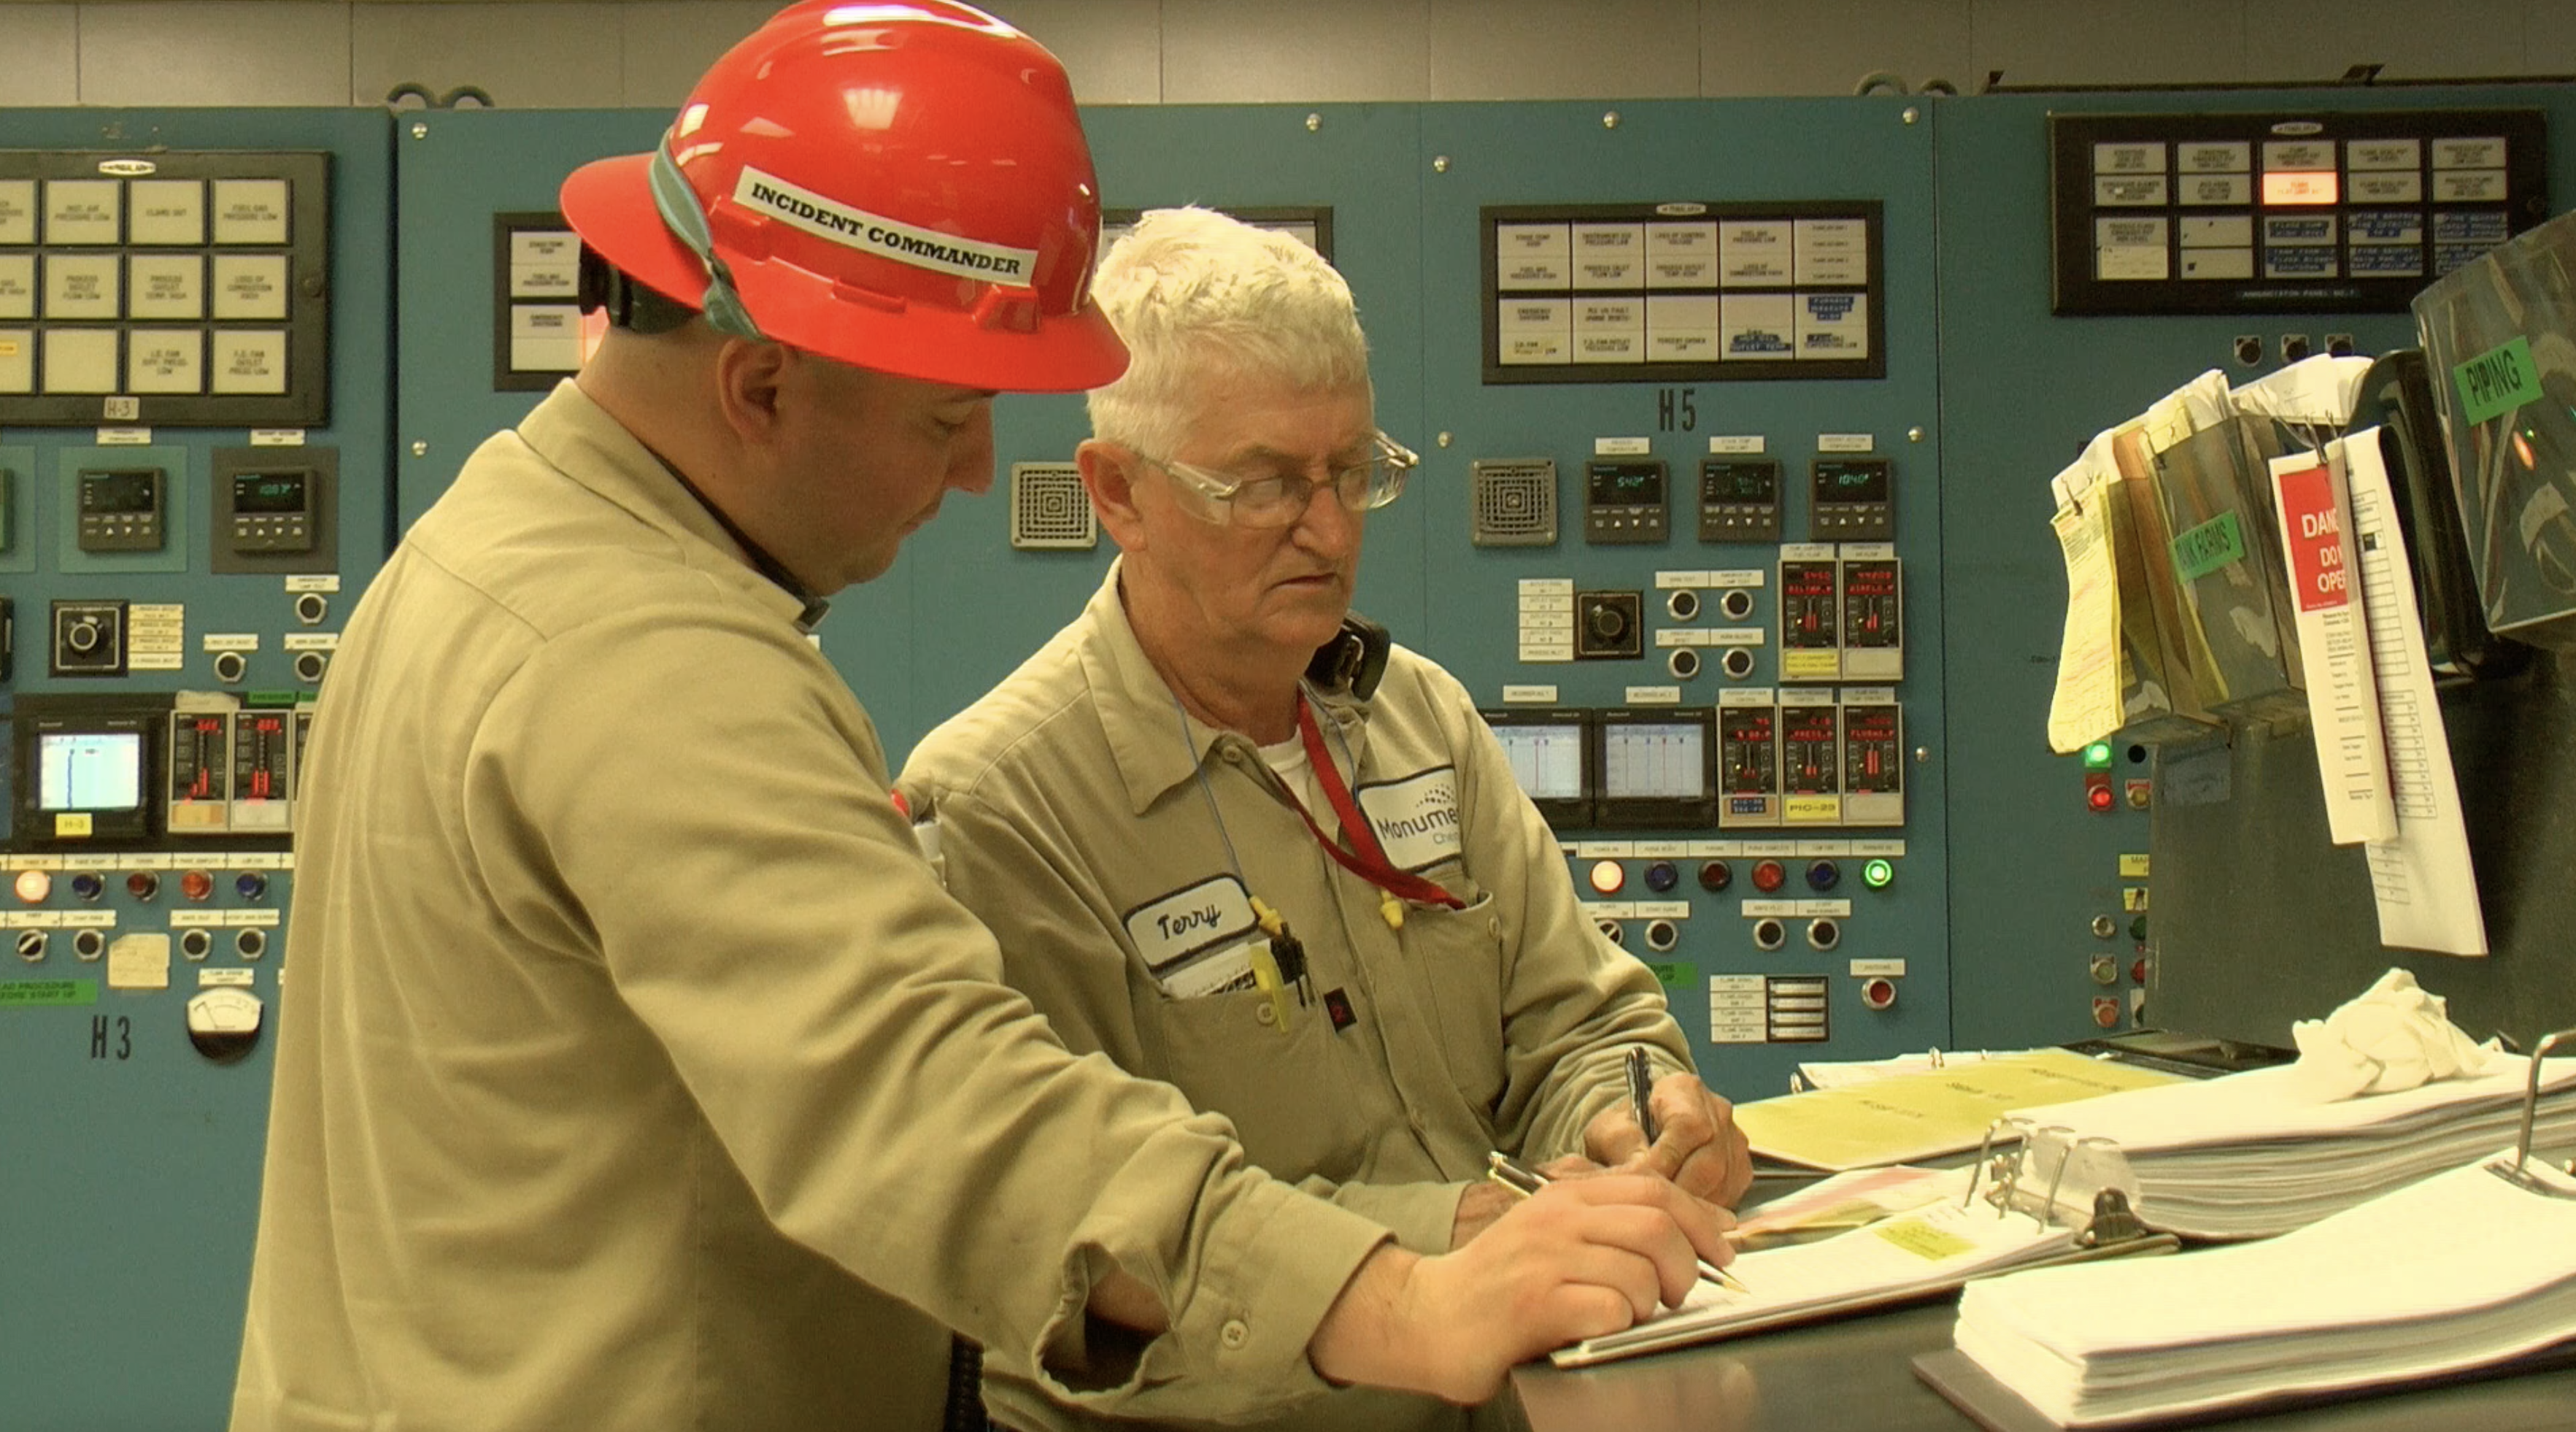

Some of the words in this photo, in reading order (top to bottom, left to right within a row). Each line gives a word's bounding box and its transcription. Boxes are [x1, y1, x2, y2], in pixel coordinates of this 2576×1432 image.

[752, 182, 863, 236] INCIDENT
[868, 226, 1020, 274] COMMANDER
[2466, 350, 2523, 407] PIPING
[107, 400, 130, 416] H-3
[1659, 389, 1695, 431] H5
[2195, 522, 2231, 562] FARMS
[1376, 807, 1459, 840] Monume
[1157, 904, 1221, 940] Terry
[18, 982, 74, 990] PROCEDURE
[30, 990, 58, 998] START
[63, 990, 75, 998] UP
[92, 1015, 131, 1060] H3
